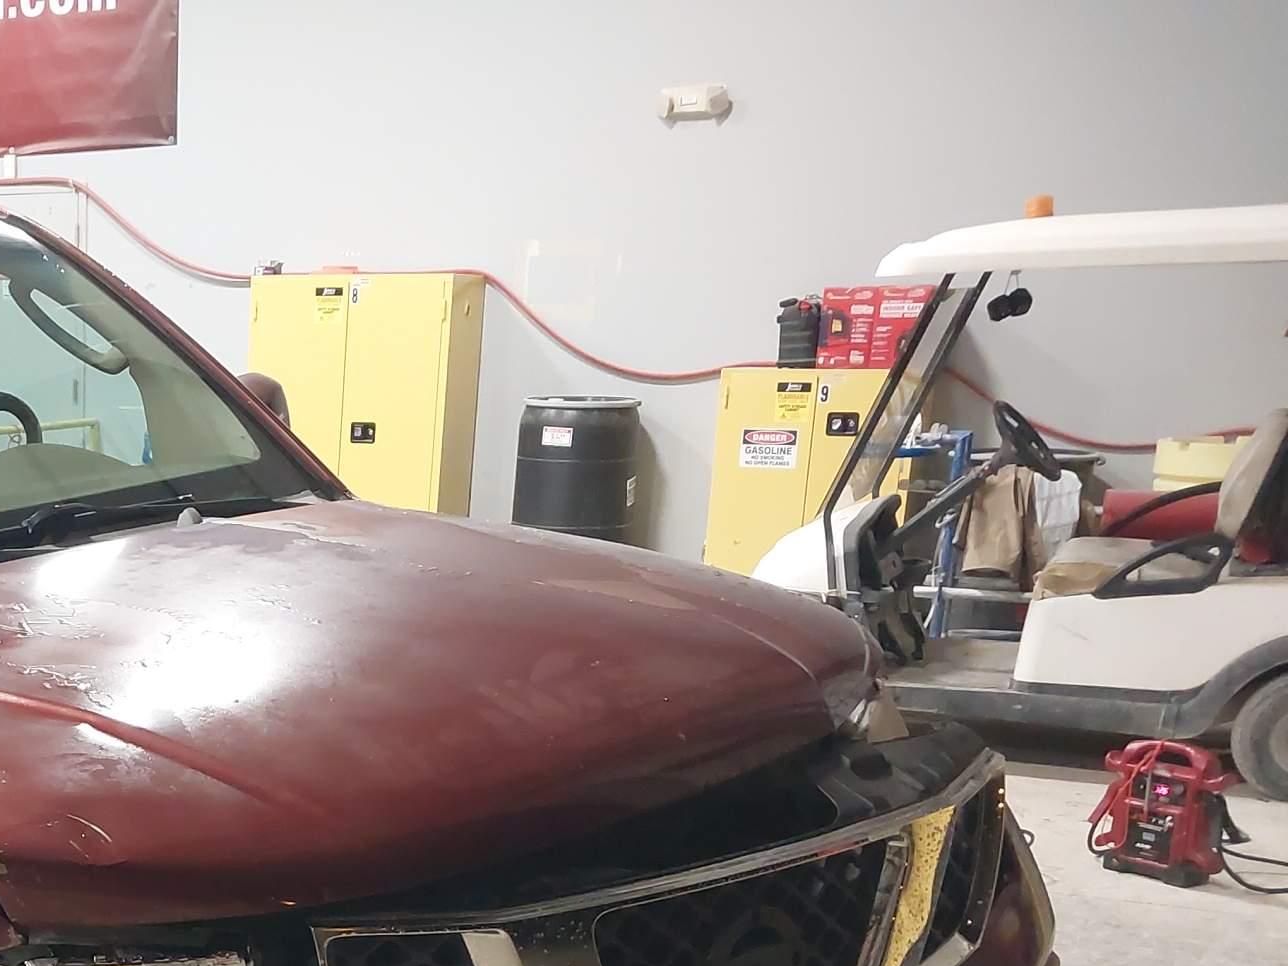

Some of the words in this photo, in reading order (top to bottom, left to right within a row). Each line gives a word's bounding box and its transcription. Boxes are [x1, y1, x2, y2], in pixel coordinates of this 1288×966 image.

[352, 288, 358, 303] 8
[820, 385, 829, 402] 9
[752, 433, 787, 442] DANGER
[745, 446, 792, 456] GASOLINE
